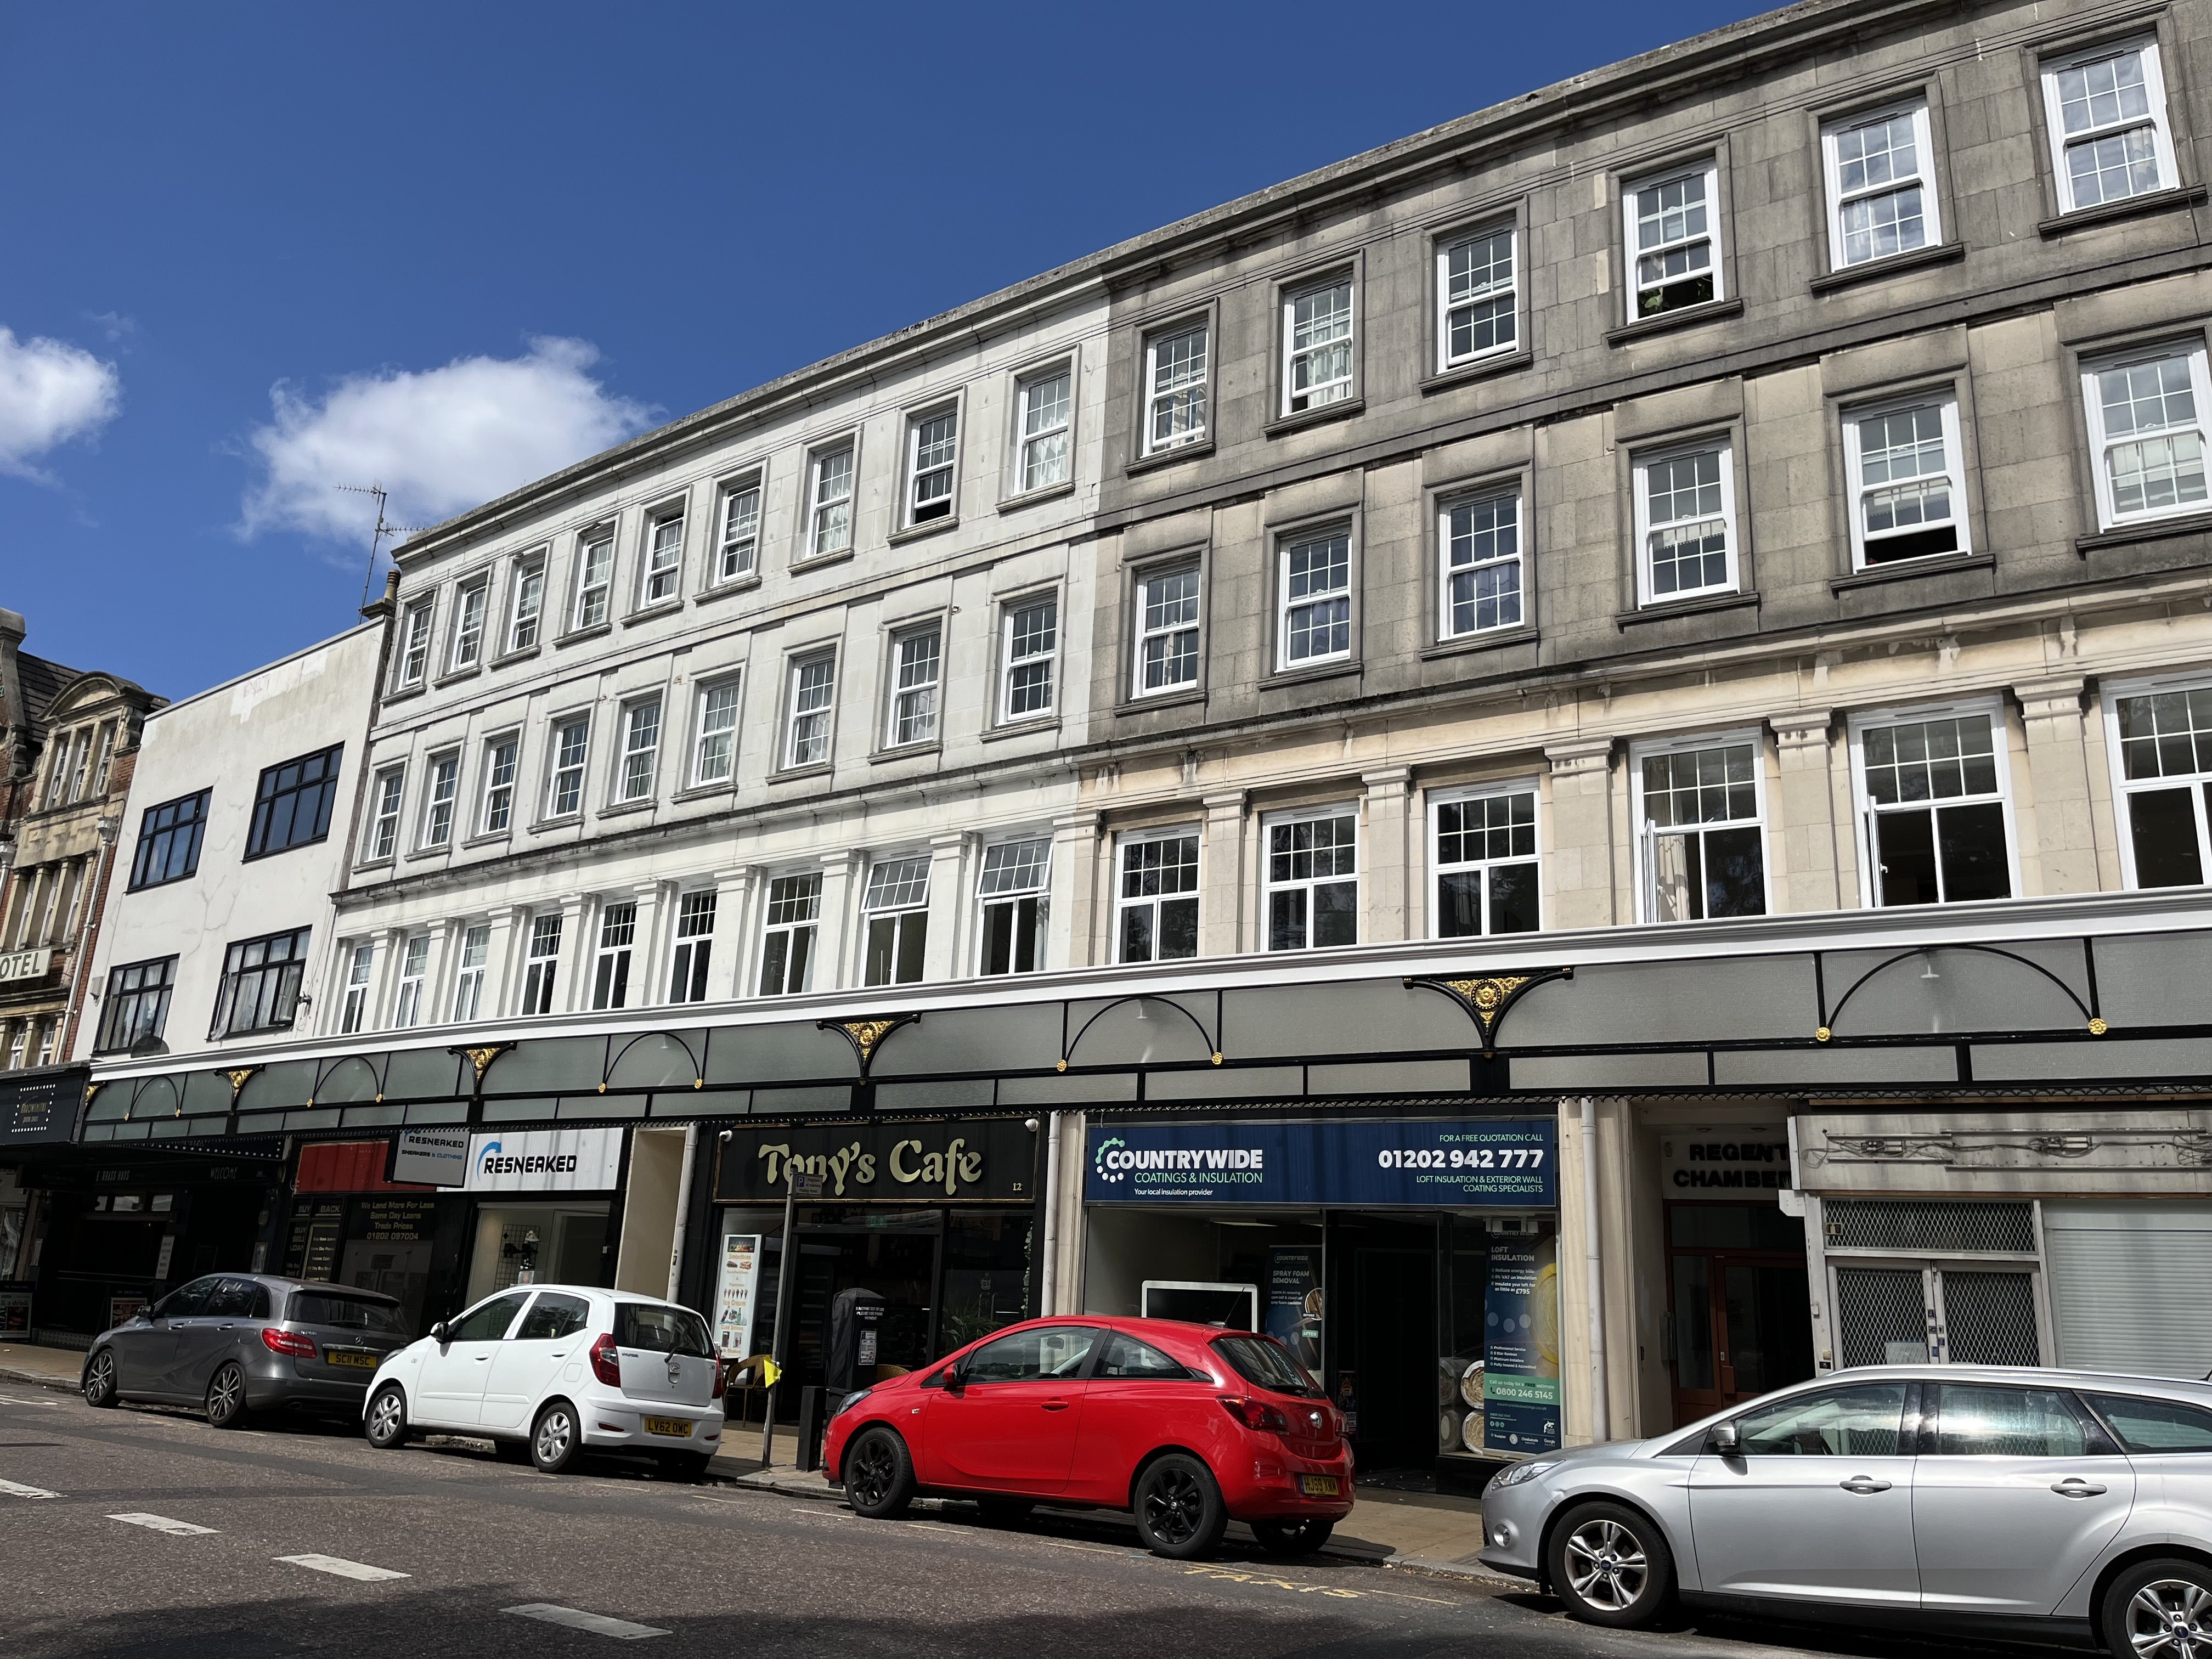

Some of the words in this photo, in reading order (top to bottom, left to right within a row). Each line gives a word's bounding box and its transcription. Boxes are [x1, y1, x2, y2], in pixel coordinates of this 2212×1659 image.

[409, 1136, 464, 1148] RESNEAKED
[1378, 1149, 1446, 1169] 01202
[1449, 1149, 1494, 1169] 942
[1498, 1149, 1544, 1168] 777
[1689, 1144, 1789, 1162] REGENT
[484, 1155, 577, 1176] RESNEAKED
[1106, 1149, 1263, 1170] COUNTRYWIDE
[758, 1141, 876, 1196] Tony's
[889, 1138, 981, 1195] Cafe
[211, 1167, 238, 1180] WELCOME
[1135, 1172, 1187, 1183] COATINGS
[1189, 1172, 1197, 1183] &
[1199, 1172, 1262, 1183] INSULATION
[1012, 1182, 1023, 1192] 12
[1188, 1188, 1213, 1197] provider
[389, 1212, 401, 1220] Day
[336, 1354, 352, 1363] SC11
[354, 1356, 370, 1365] MSC
[1496, 1387, 1516, 1396] 0800
[1518, 1389, 1533, 1398] 246
[1534, 1391, 1553, 1399] 5145
[648, 1420, 670, 1432] LV62
[1304, 1477, 1322, 1491] HJ69
